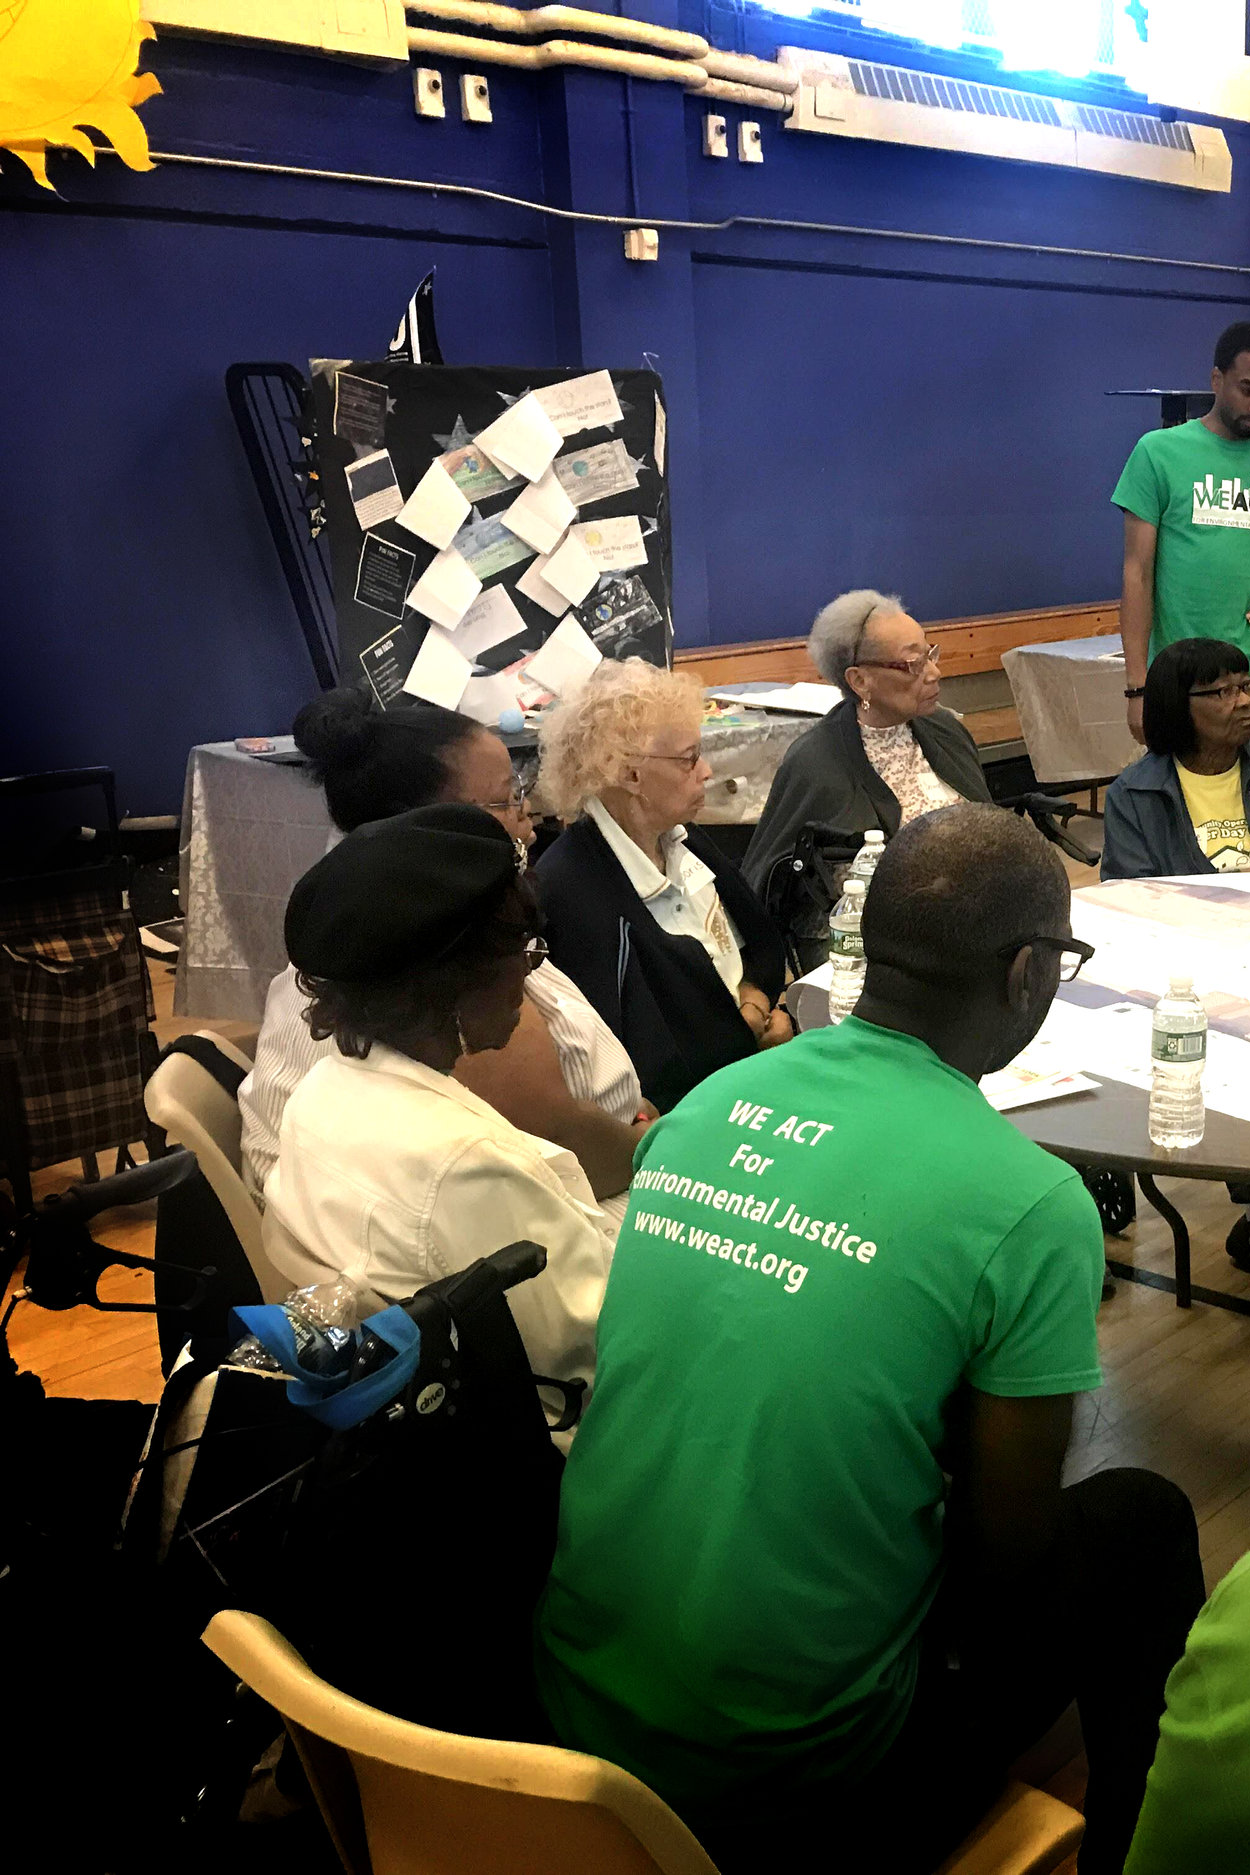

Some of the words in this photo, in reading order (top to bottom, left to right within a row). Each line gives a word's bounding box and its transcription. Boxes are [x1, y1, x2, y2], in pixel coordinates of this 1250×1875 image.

[1220, 828, 1246, 839] Day
[728, 1100, 774, 1131] WE
[773, 1115, 834, 1147] ACT
[729, 1143, 774, 1176] For
[634, 1211, 809, 1294] www.weact.org
[774, 1203, 878, 1264] Justice
